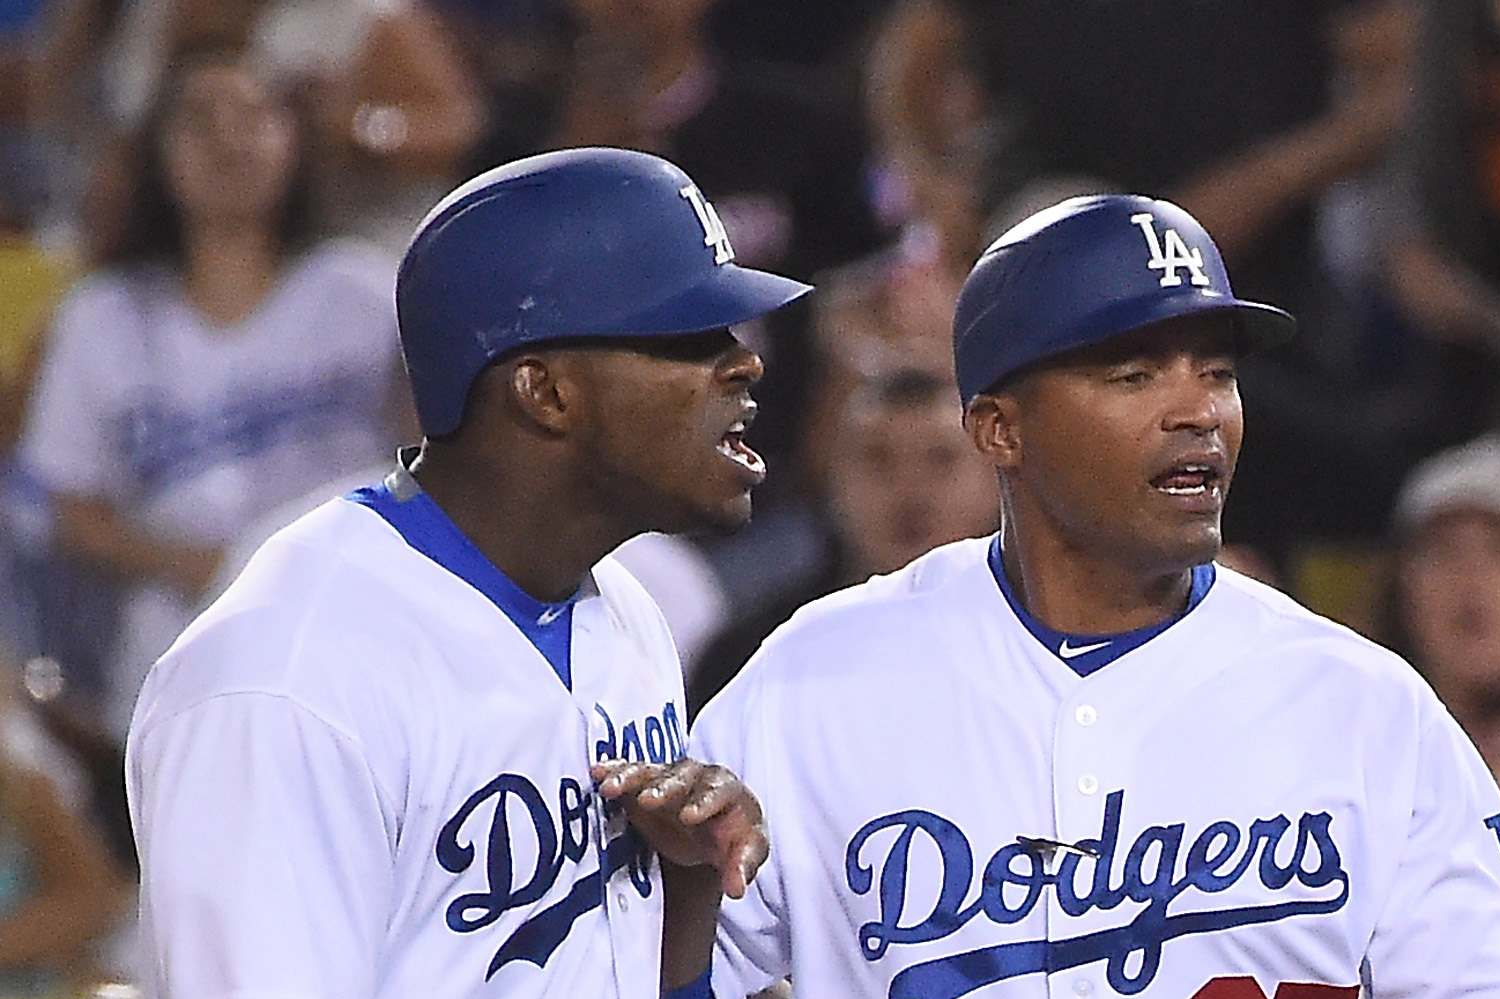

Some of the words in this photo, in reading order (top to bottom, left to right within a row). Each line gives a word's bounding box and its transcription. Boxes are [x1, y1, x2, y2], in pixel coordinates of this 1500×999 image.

[679, 185, 735, 264] LA
[1130, 213, 1210, 287] LA
[847, 788, 1350, 999] Dodgers
